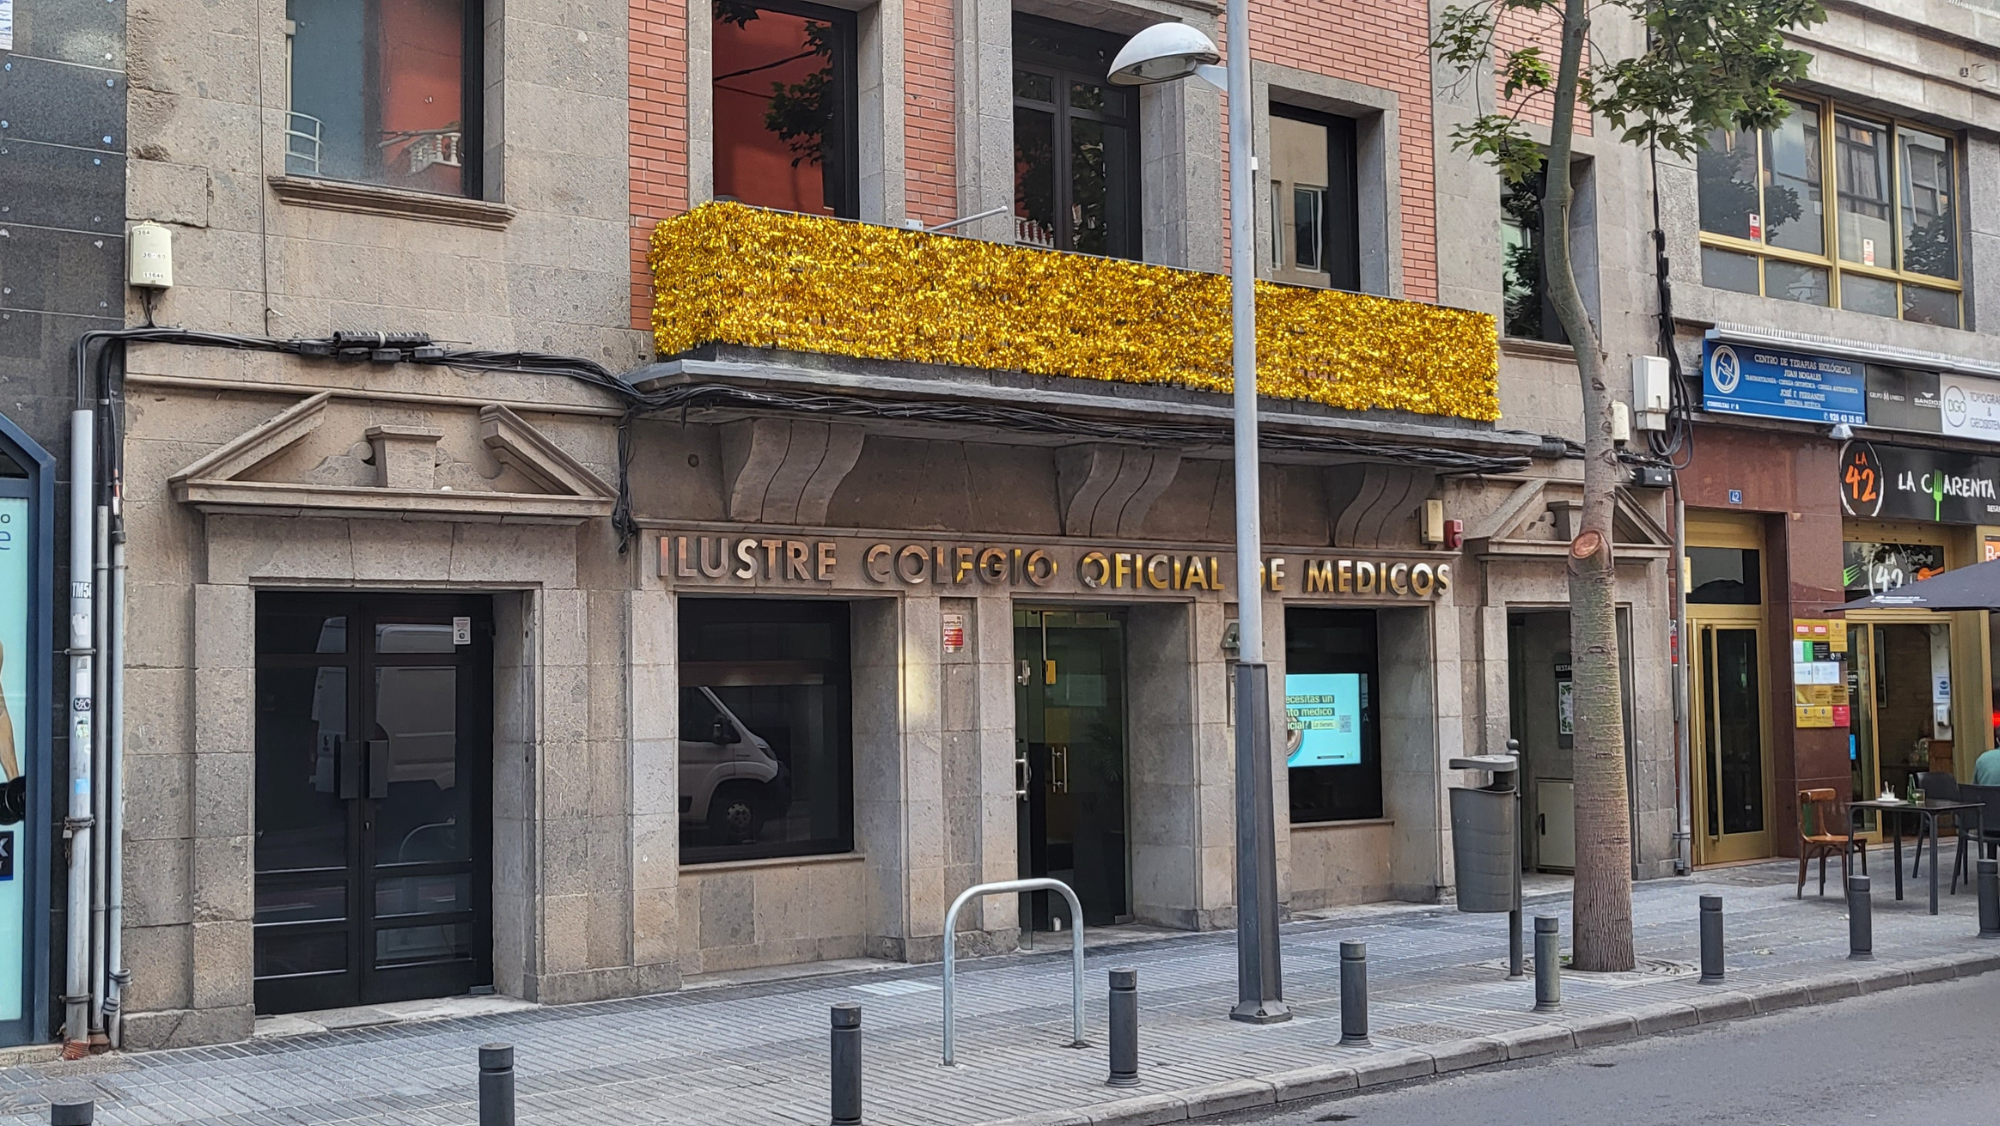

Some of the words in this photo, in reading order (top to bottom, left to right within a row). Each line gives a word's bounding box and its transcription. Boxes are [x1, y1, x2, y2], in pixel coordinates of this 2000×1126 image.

[1754, 353, 1778, 365] CENTRO
[1780, 357, 1789, 366] DE
[1790, 358, 1817, 370] TERAPIAS
[1855, 451, 1868, 466] LA
[1845, 464, 1877, 502] 42
[1897, 470, 1916, 493] LA
[656, 536, 838, 581] ILUSTRE
[864, 543, 1057, 588] COLEGIO
[1078, 551, 1226, 592] OFICIAL
[1304, 558, 1451, 597] MEDICOS
[1885, 551, 1897, 566] LA
[1875, 565, 1904, 593] 42
[1322, 695, 1333, 703] un
